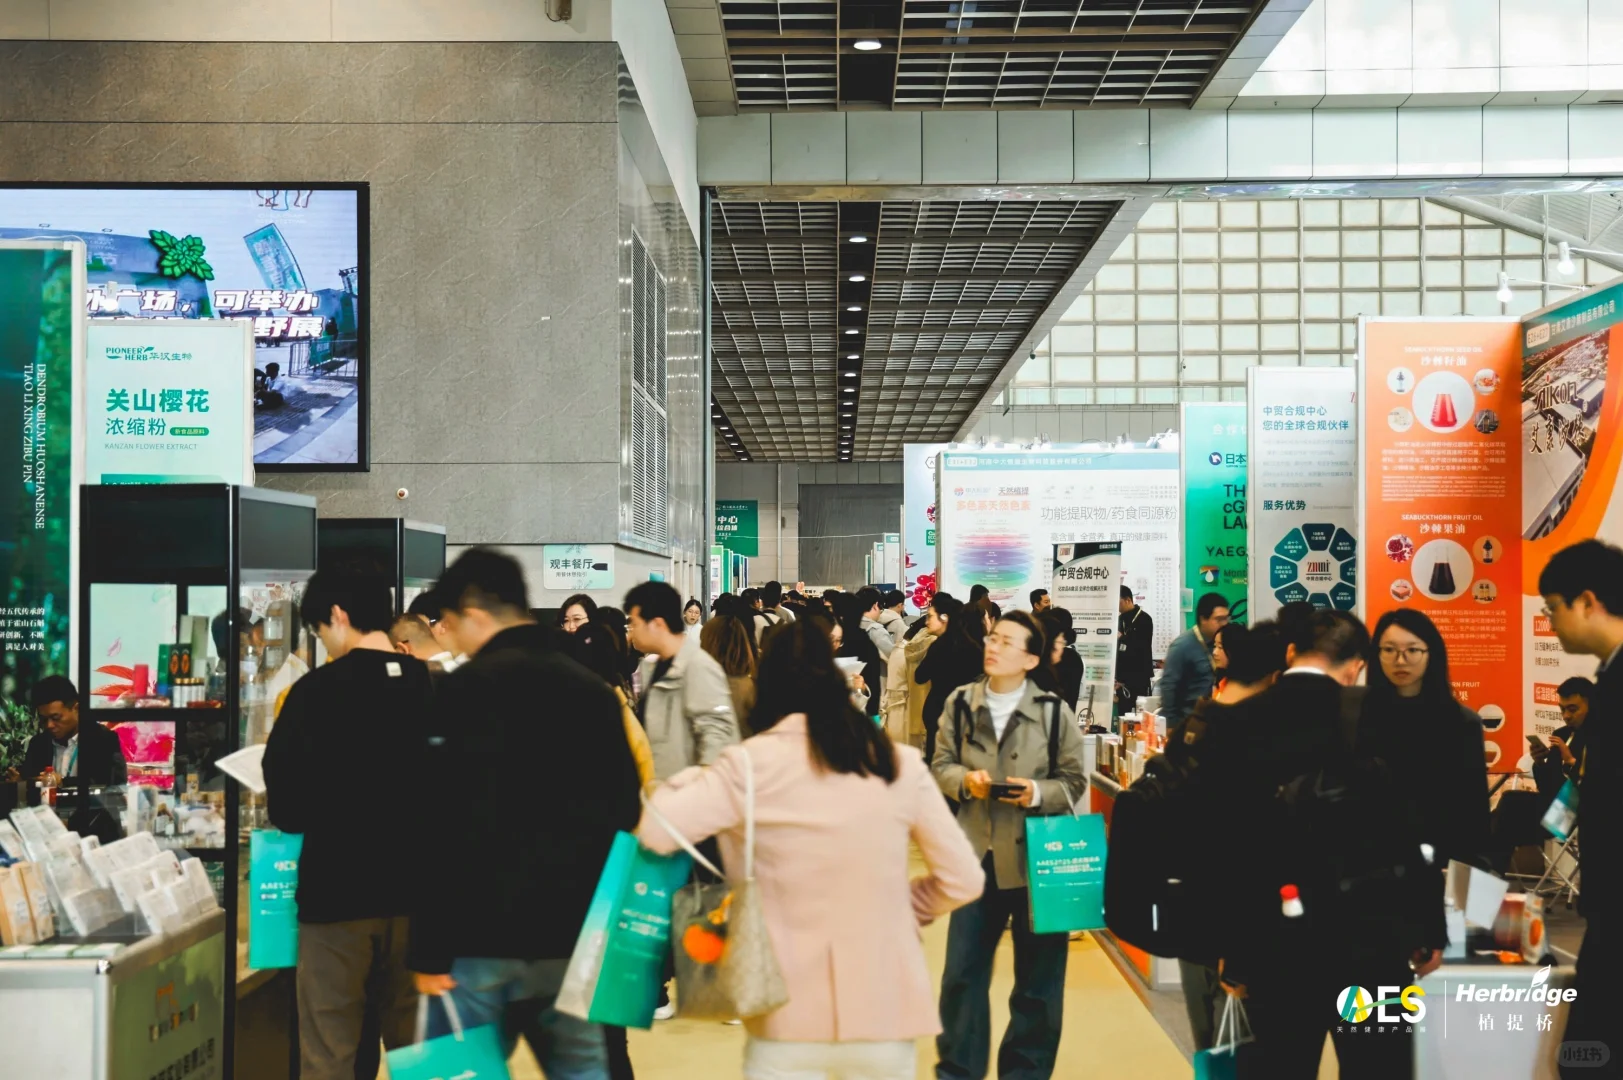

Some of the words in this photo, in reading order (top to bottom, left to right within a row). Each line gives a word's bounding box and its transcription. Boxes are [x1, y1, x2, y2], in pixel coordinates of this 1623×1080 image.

[149, 352, 193, 361] 华汉生物
[1420, 355, 1467, 367] 沙棘籽油
[23, 363, 33, 391] TIAO
[36, 363, 46, 441] DENDROBIUM
[106, 388, 210, 413] 关山樱花
[1263, 406, 1327, 416] 中贸合规中心
[23, 405, 33, 434] XING
[105, 417, 167, 436] 浓缩粉
[1262, 420, 1349, 431] 您的全球合规伙伴
[23, 436, 33, 463] ZIBU
[23, 465, 33, 483] PIN
[35, 443, 46, 529] HUOSHANENSE
[1041, 505, 1178, 521] 功能提取物/药食同源粉
[1263, 500, 1306, 511] 服务优势
[1419, 523, 1466, 535] 沙棘果油
[550, 558, 593, 570] 观丰餐厅
[1059, 566, 1110, 580] 中贸合规中心
[5, 643, 45, 651] 满足人对美
